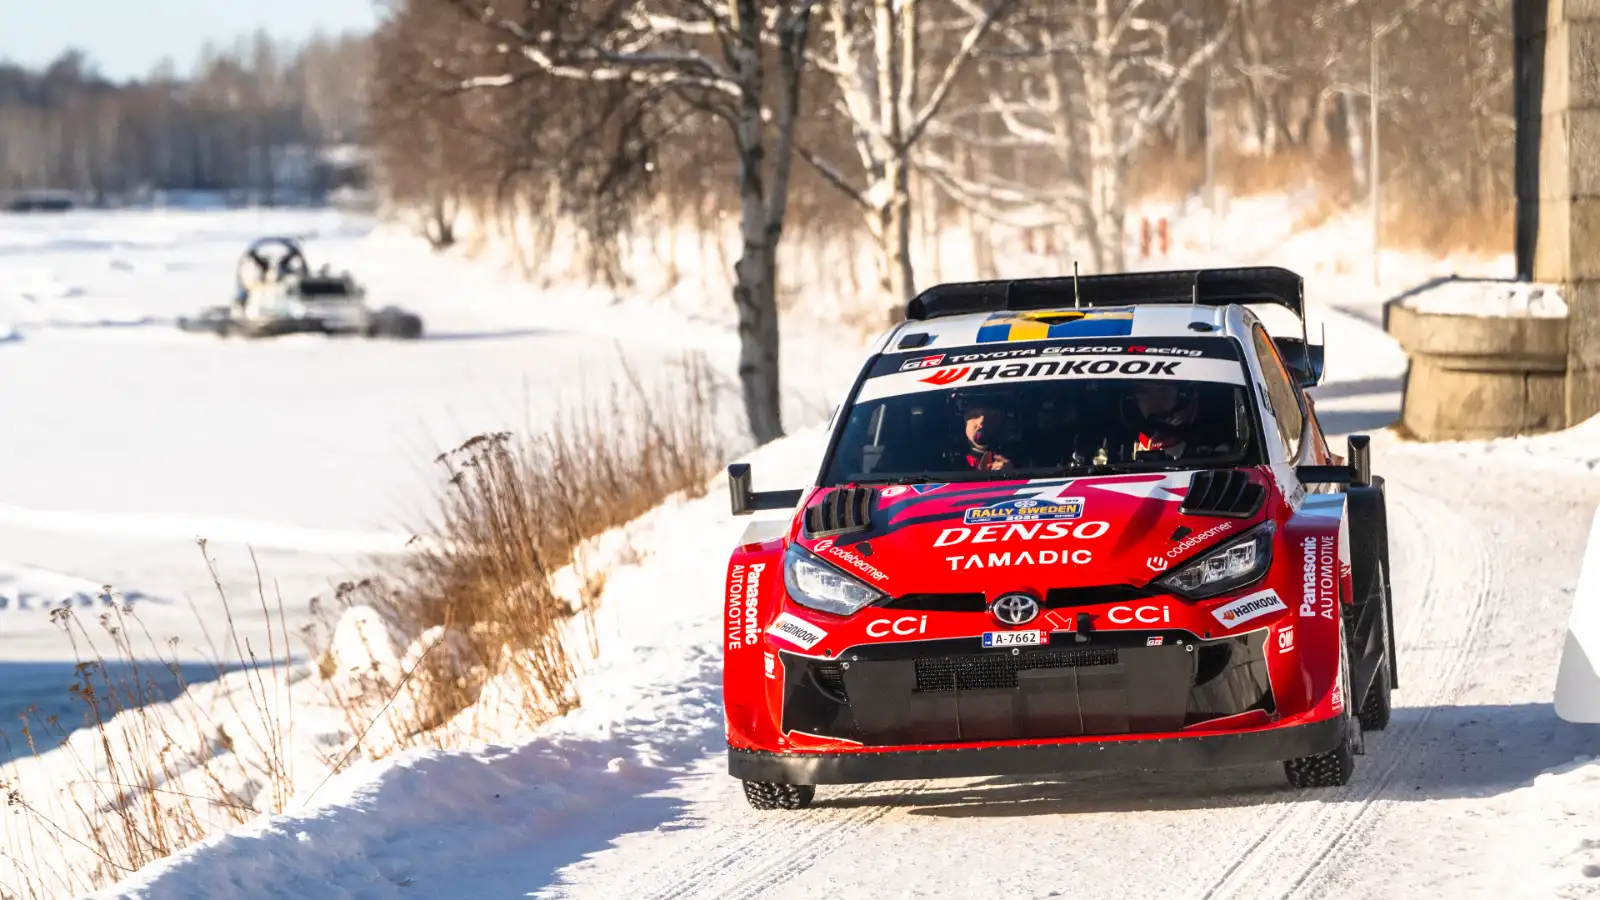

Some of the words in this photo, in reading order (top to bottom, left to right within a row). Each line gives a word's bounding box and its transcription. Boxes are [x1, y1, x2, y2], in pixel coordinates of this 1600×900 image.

[900, 357, 944, 371] GR
[949, 349, 1036, 363] TOYOTA
[1042, 346, 1123, 356] GAZOO
[1127, 345, 1203, 357] Racing
[972, 507, 1014, 518] RALLY
[1018, 504, 1077, 515] SWEDEN
[932, 521, 1111, 547] DENSO
[1167, 521, 1231, 558] codebeamer
[829, 545, 887, 582] codebeamer
[945, 549, 1092, 571] TAMADIC
[1299, 536, 1317, 617] Panasonic
[1320, 535, 1334, 620] AUTOMOTIVE
[728, 564, 745, 650] AUTOMOTIVE
[745, 563, 766, 645] Panasonic
[995, 632, 1036, 644] A-7662
